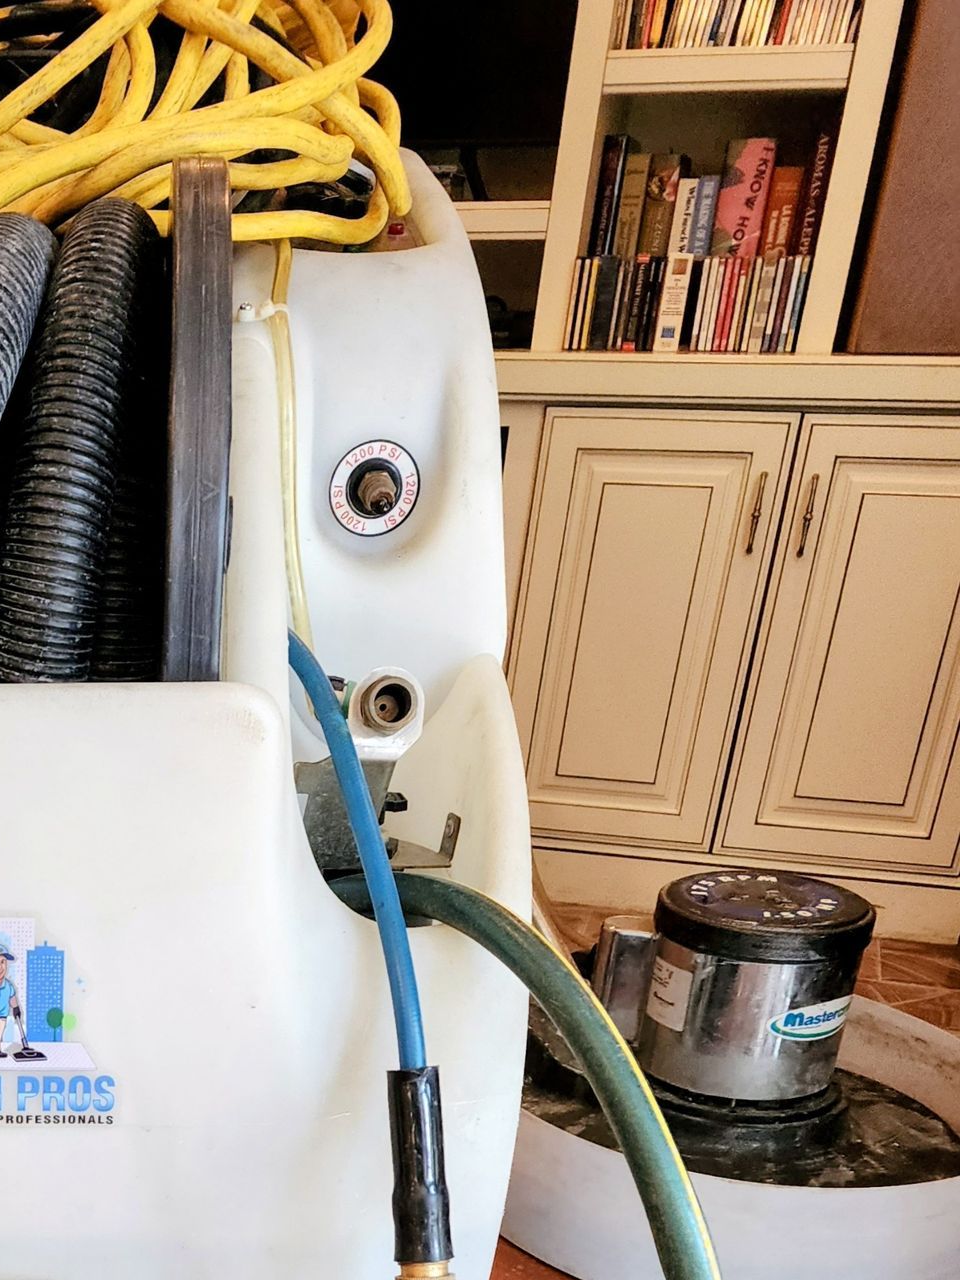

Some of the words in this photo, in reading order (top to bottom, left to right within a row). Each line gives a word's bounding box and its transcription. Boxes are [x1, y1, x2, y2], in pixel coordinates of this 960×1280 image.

[809, 133, 830, 196] AROMAS
[744, 157, 770, 211] KNOW
[684, 186, 697, 211] When
[728, 216, 750, 256] HOW
[799, 206, 816, 254] ALEPP
[345, 446, 373, 467] 1200
[379, 445, 401, 460] PSI
[334, 486, 344, 509] PSI
[404, 472, 416, 504] 1200
[341, 511, 366, 531] 1200
[384, 508, 405, 528] PSI
[690, 879, 716, 897] 175
[717, 874, 778, 883] RPM
[16, 1074, 116, 1113] PROS
